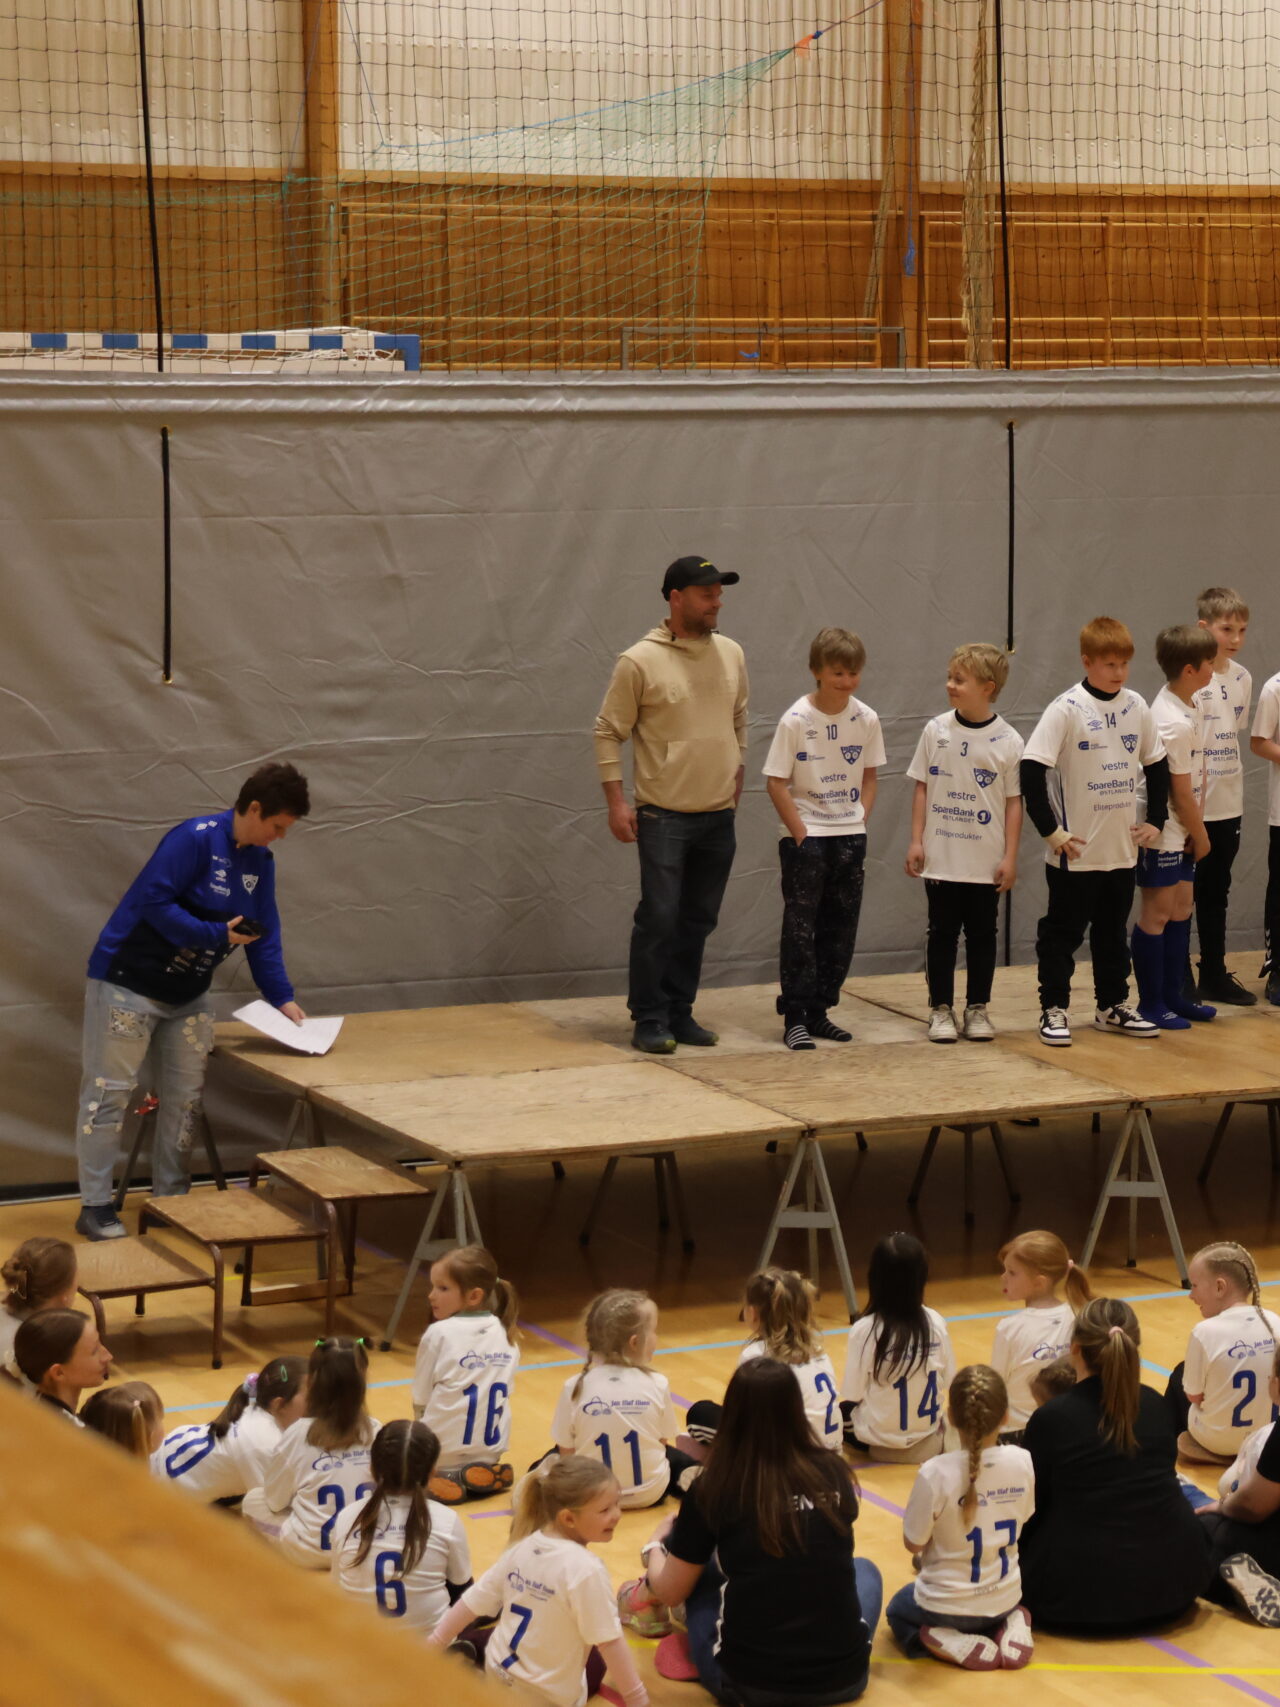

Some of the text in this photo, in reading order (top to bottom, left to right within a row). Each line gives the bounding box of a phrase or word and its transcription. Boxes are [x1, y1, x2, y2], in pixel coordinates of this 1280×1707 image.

[1221, 685, 1228, 700] 5
[1105, 712, 1116, 728] 14
[826, 724, 838, 740] 10
[960, 741, 968, 757] 3
[1102, 761, 1128, 771] vestre
[821, 773, 847, 784] vestre
[808, 790, 848, 800] SpareBank
[947, 790, 976, 801] vestre
[932, 804, 975, 817] SpareBank
[936, 828, 982, 841] Eliteprodukter
[893, 1370, 940, 1431] 14
[463, 1382, 508, 1446] 16
[594, 1430, 642, 1486] 11
[966, 1519, 1017, 1583] 17
[375, 1551, 407, 1617] 6
[501, 1603, 532, 1669] 7
